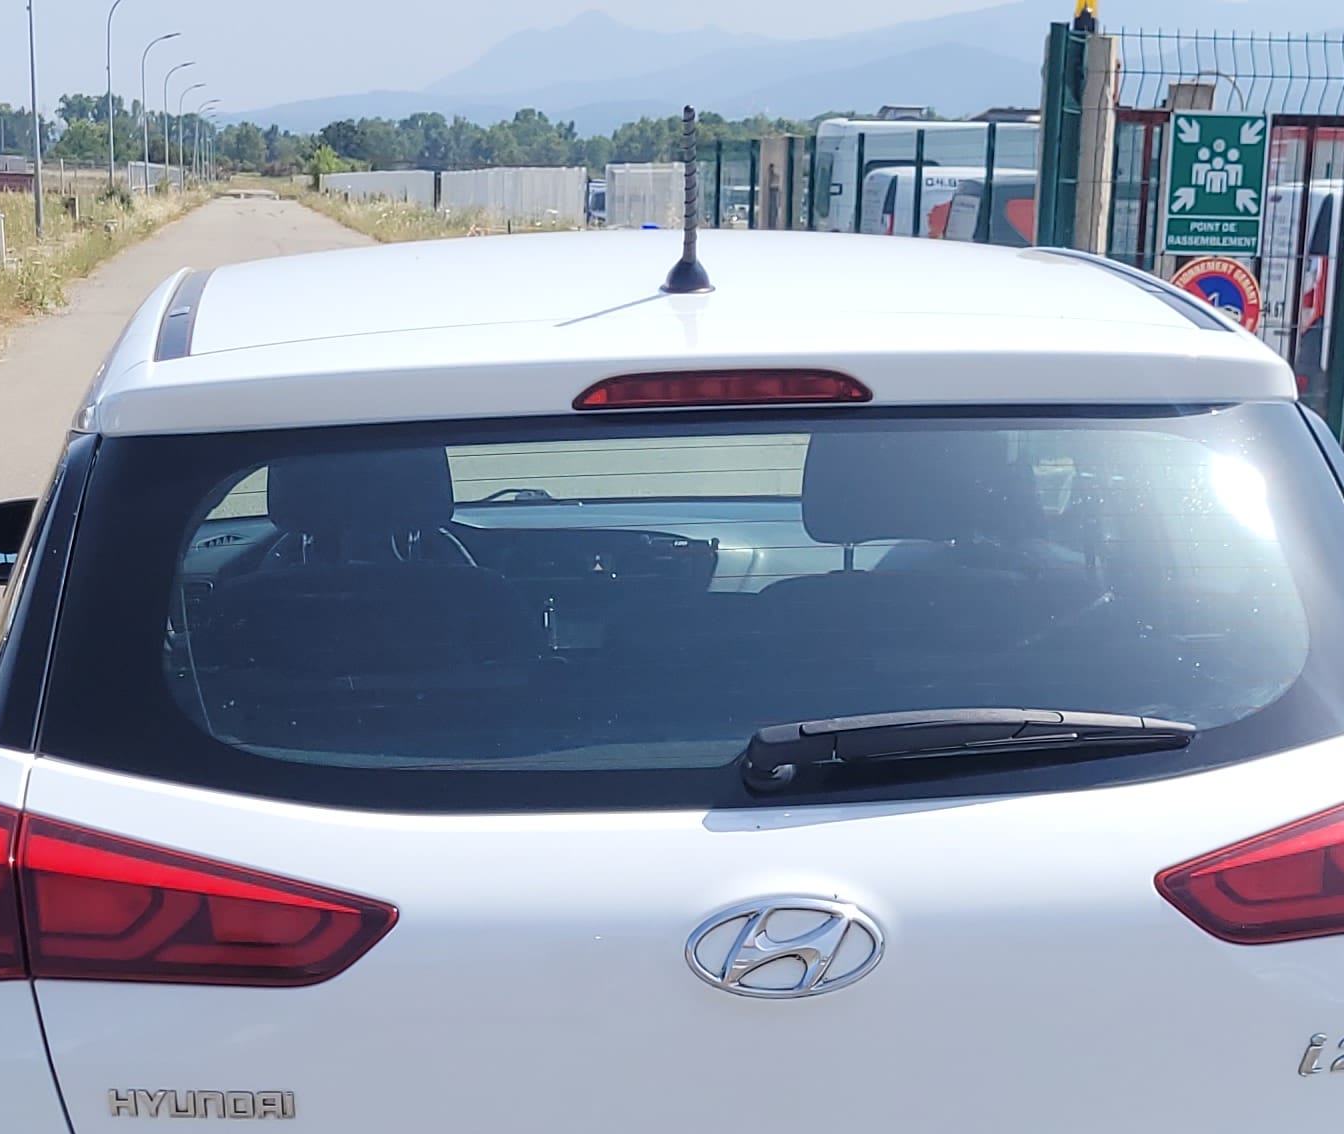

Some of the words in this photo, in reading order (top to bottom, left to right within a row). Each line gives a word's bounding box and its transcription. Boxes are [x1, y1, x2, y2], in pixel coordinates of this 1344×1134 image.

[1189, 221, 1220, 232] POINT
[1222, 222, 1237, 232] DE
[1167, 235, 1256, 247] RASSEMBLEMENT
[108, 1089, 296, 1119] HYUNDAI
